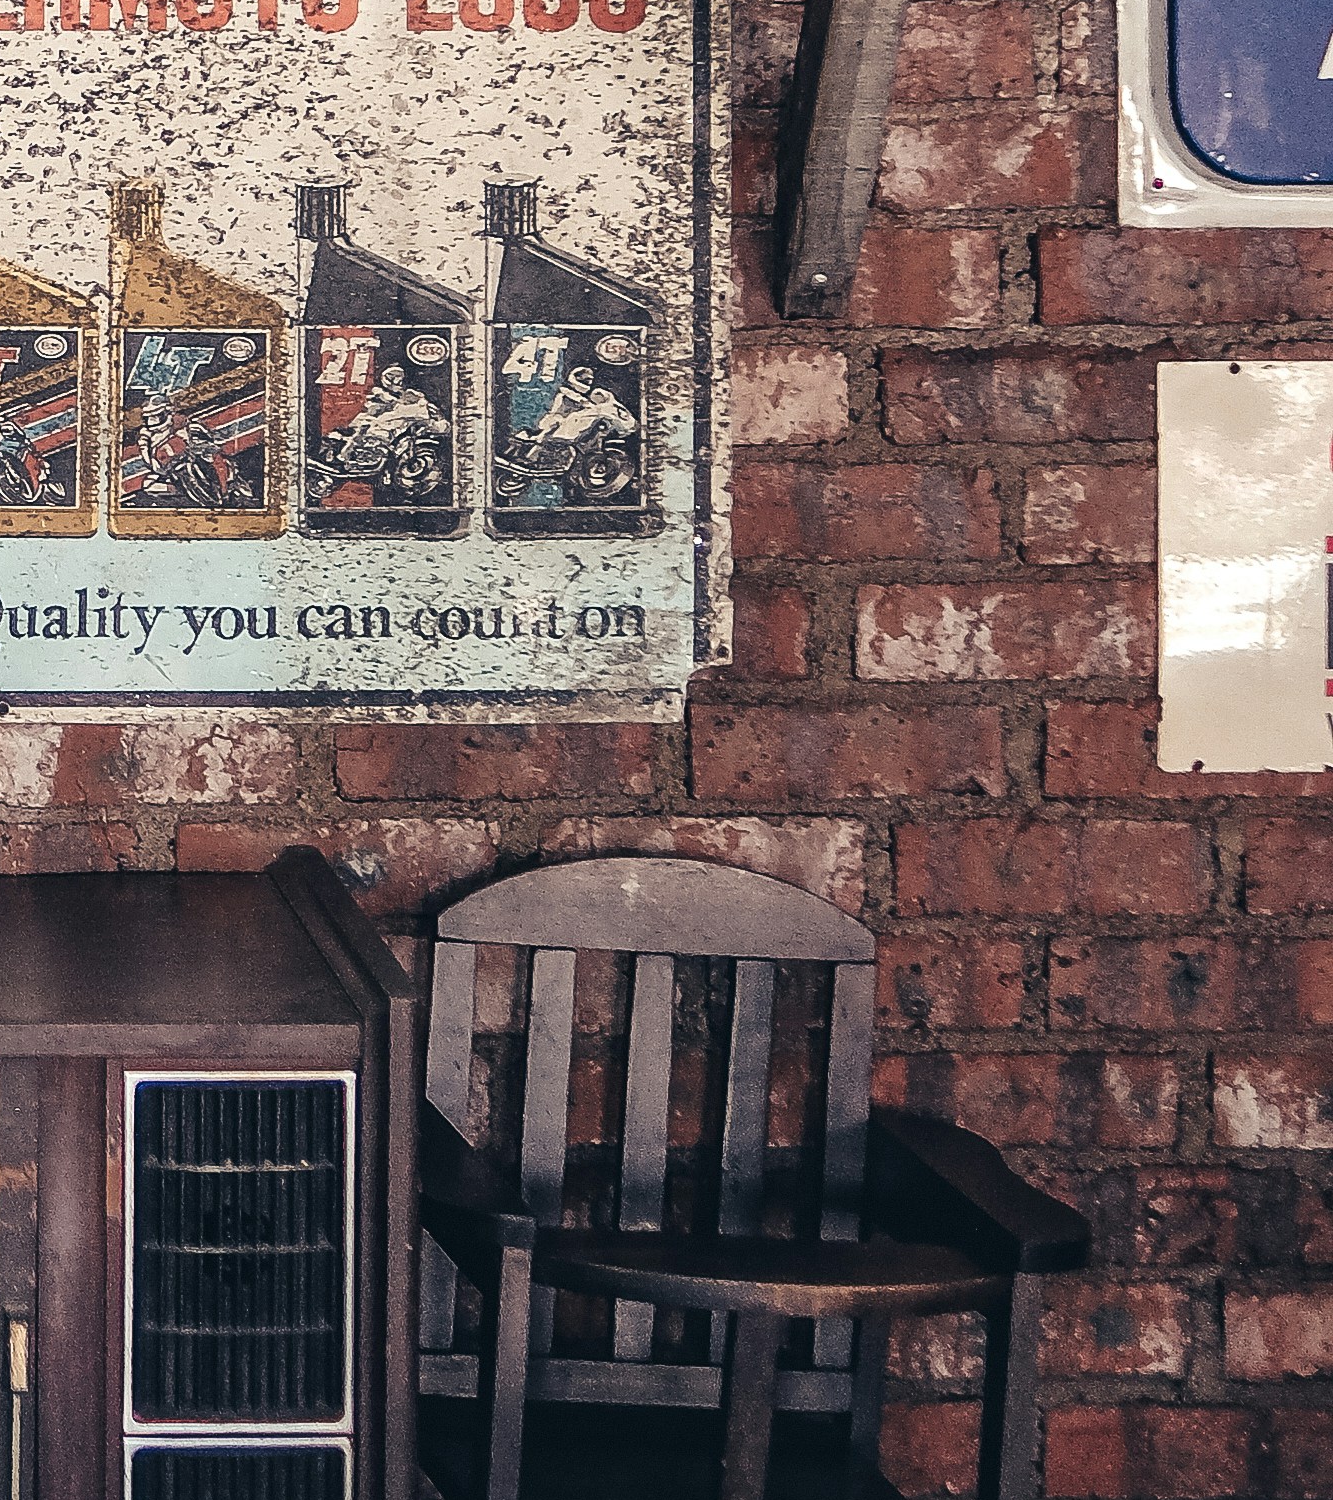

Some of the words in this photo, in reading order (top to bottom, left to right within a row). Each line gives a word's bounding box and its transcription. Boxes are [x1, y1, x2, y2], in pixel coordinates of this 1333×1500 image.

[314, 336, 381, 386] 2T
[502, 335, 570, 384] 4T
[180, 604, 282, 656] you
[294, 602, 396, 641] can
[573, 602, 649, 641] on
